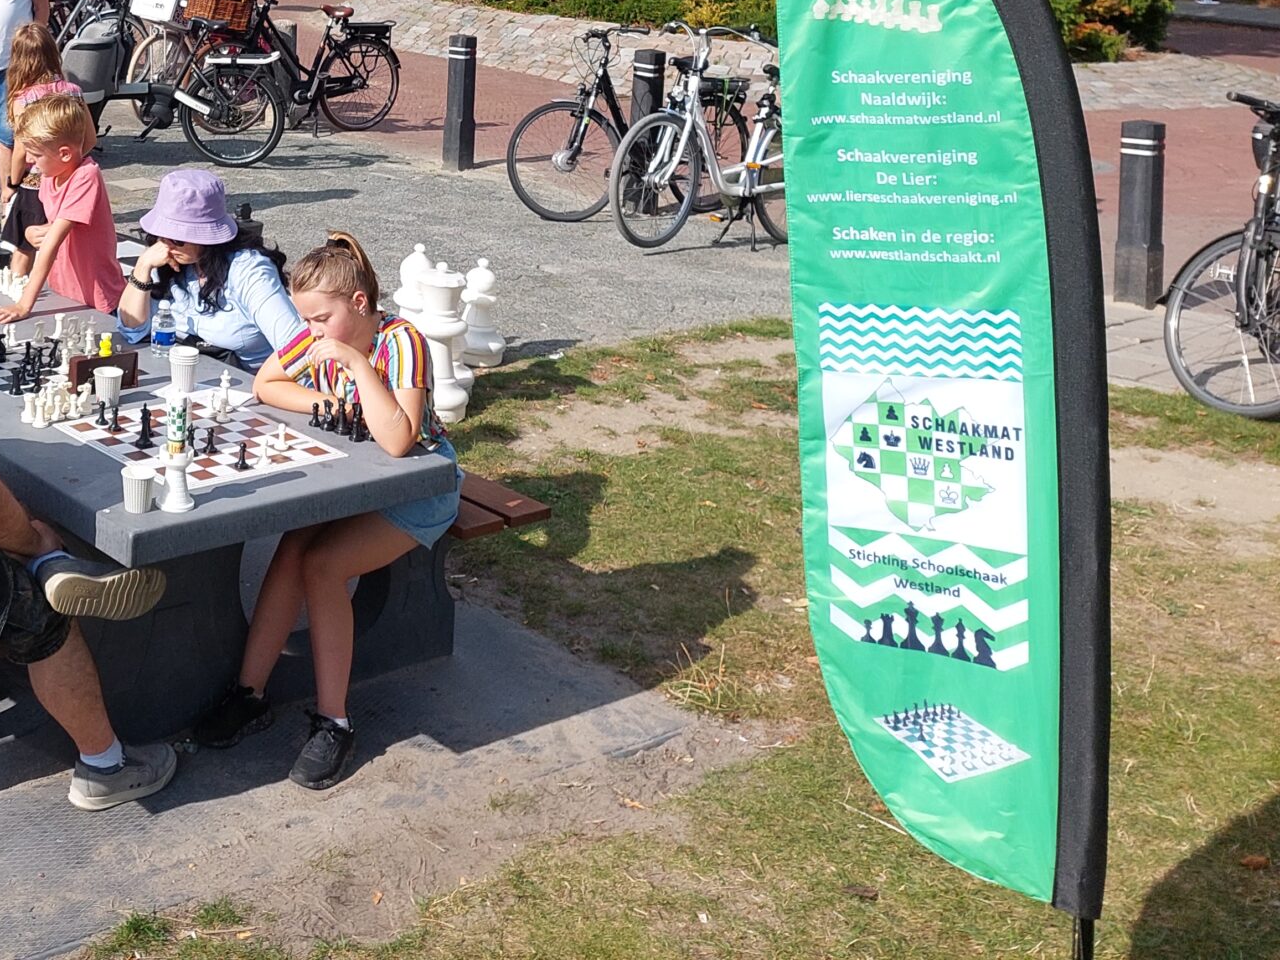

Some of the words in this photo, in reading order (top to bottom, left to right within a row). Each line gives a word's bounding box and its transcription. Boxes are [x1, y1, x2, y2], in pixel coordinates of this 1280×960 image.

[831, 69, 972, 86] Schaakvereniging
[860, 92, 947, 108] Naaldwijk:
[811, 111, 1001, 126] www.schaakmatwestland.nl
[836, 148, 978, 165] Schaakvereniging
[876, 171, 898, 185] De
[902, 171, 938, 186] Lier:
[806, 190, 1017, 206] www.lierseschaakvereniging.nl
[832, 226, 897, 242] Schaken
[901, 229, 916, 243] in
[921, 229, 942, 243] de
[946, 230, 995, 247] regio:
[829, 249, 1001, 263] www.westlandschaakt.nl
[910, 415, 1023, 442] SCHAAKMAT
[918, 435, 1015, 461] WESTLAND
[848, 548, 908, 570] Stichting
[911, 558, 1008, 585] Schoolschaak
[894, 577, 961, 598] Westland
